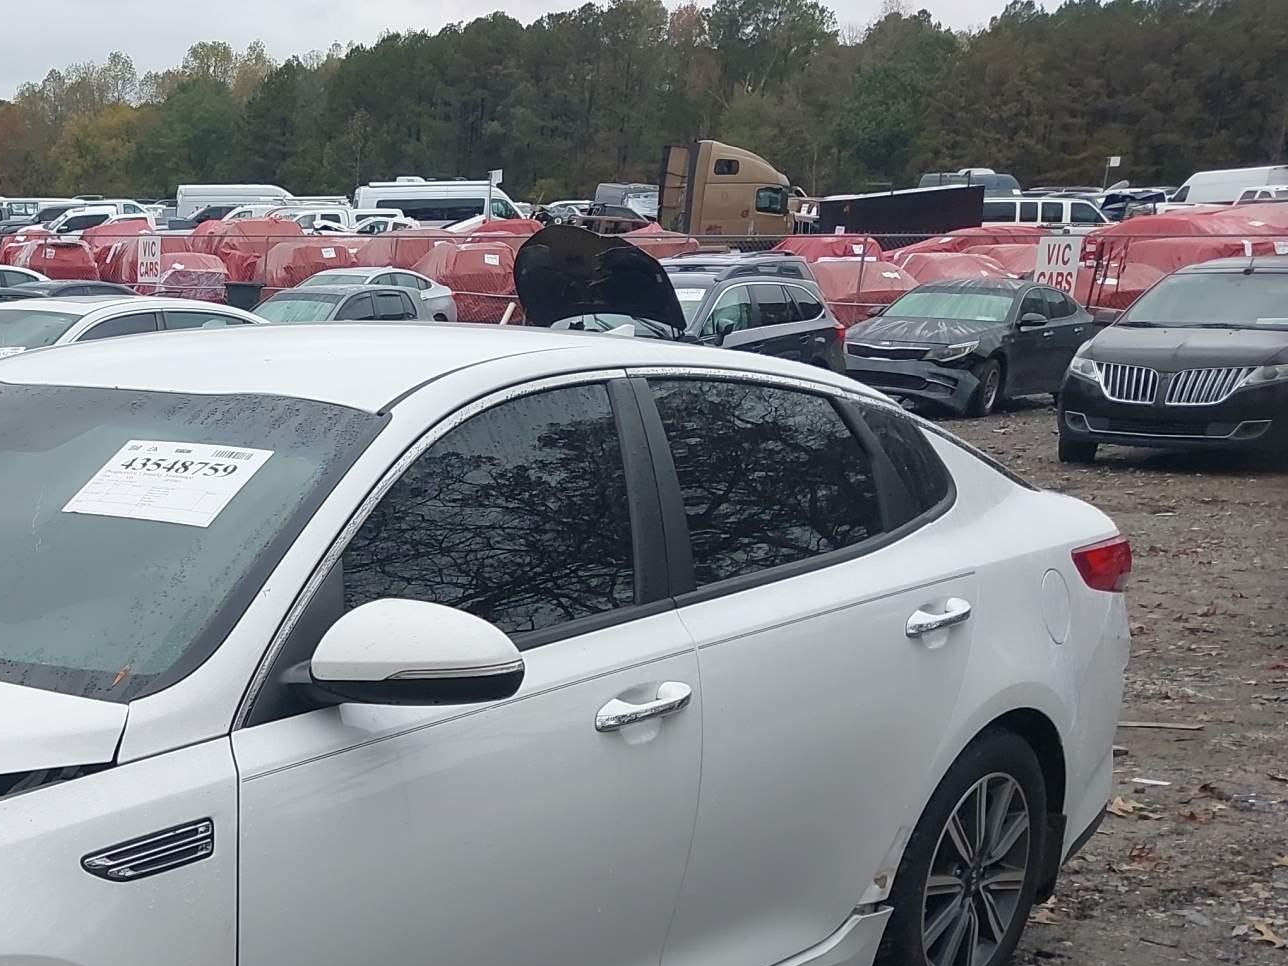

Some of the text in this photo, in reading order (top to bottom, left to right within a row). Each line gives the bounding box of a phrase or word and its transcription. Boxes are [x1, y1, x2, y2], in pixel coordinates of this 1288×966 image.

[142, 241, 157, 257] VIC
[1047, 243, 1072, 266] VIC
[139, 261, 159, 278] CARS
[121, 457, 238, 477] 43548759
